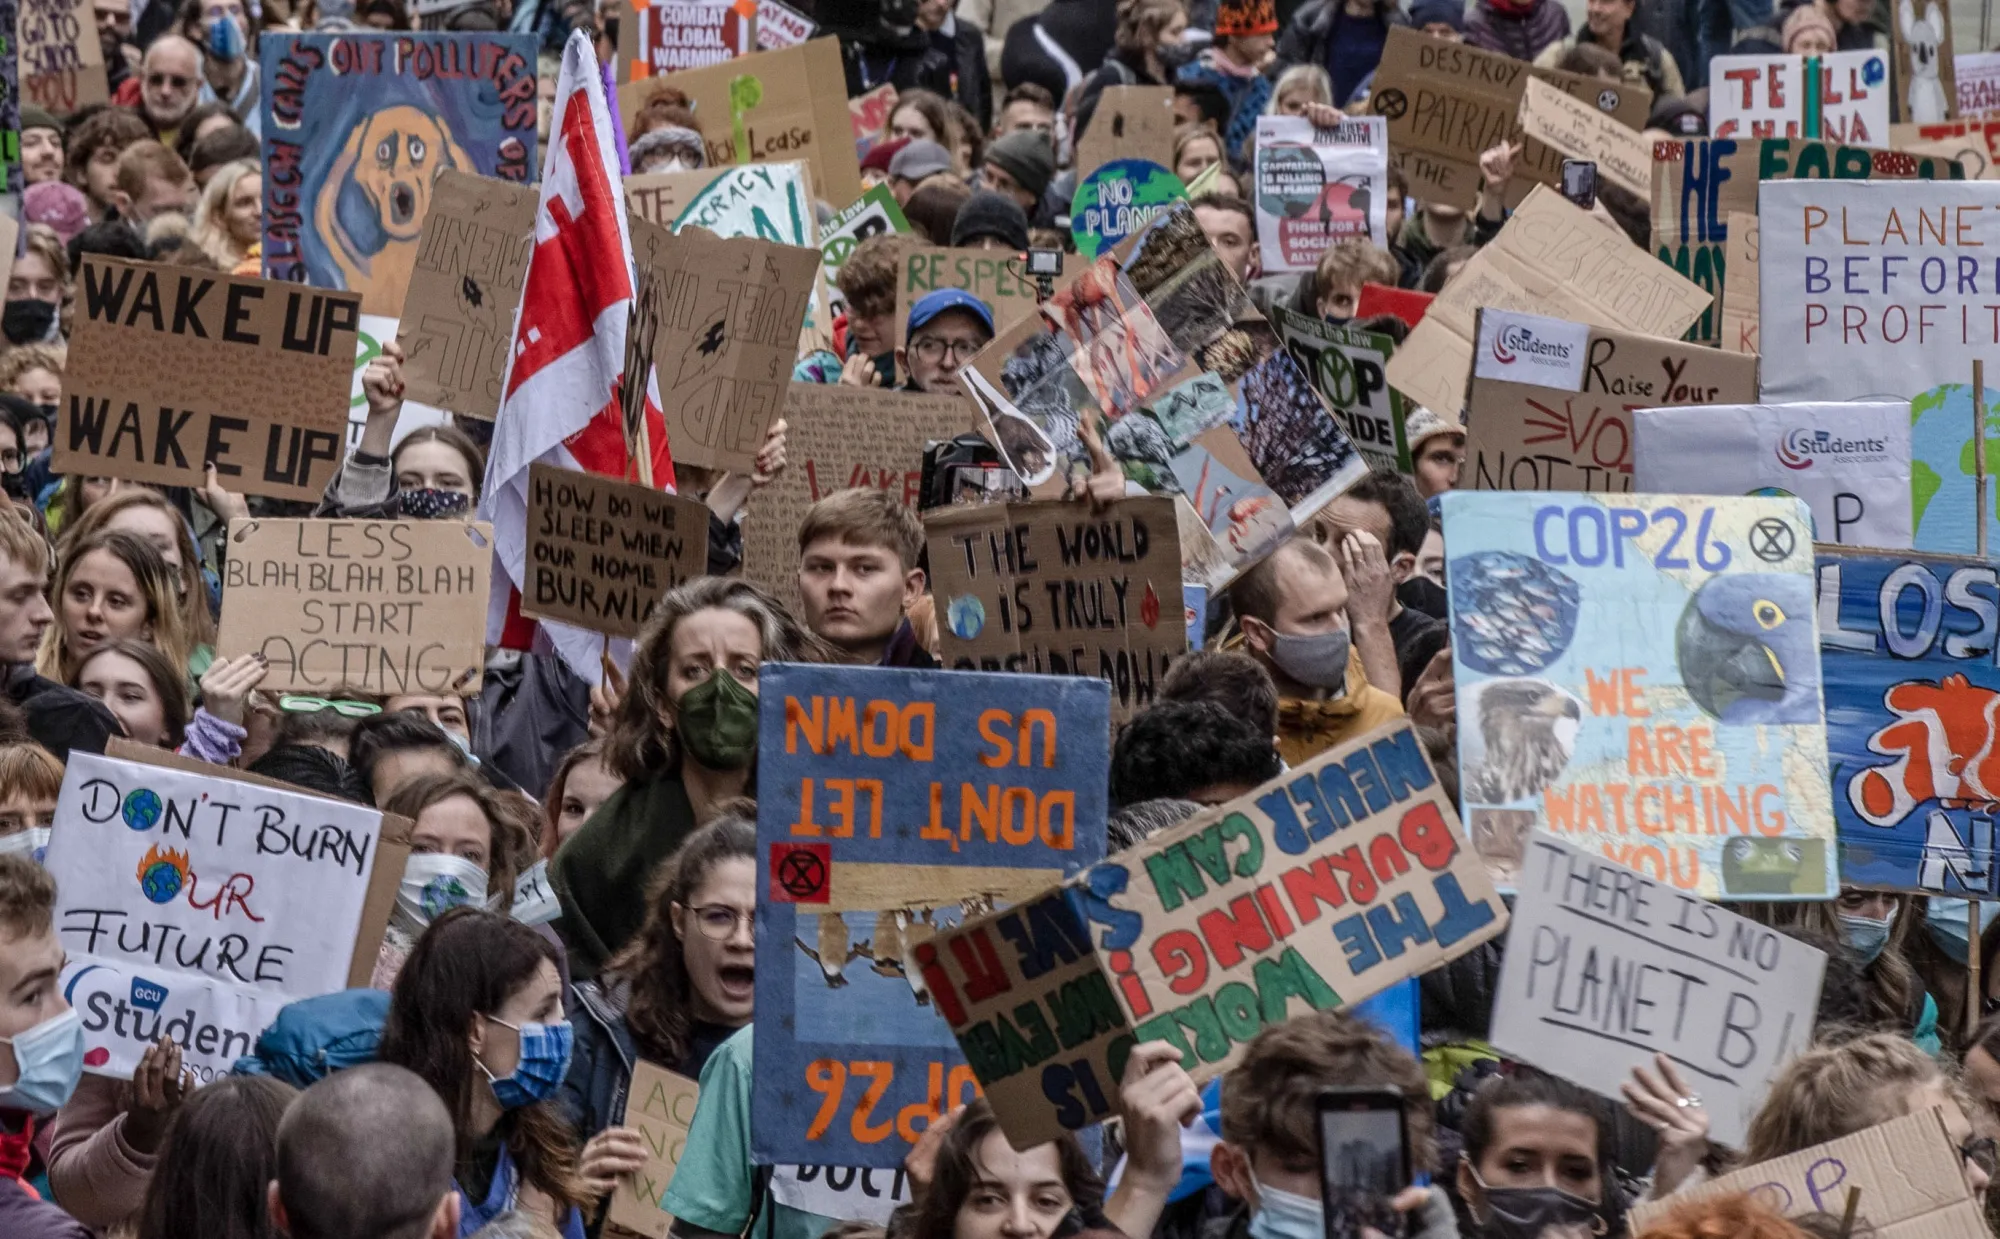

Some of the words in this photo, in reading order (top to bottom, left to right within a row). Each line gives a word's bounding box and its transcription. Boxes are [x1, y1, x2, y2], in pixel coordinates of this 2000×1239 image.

[660, 7, 727, 26] COMBAT
[662, 27, 725, 48] GLOBAL
[328, 38, 386, 77] OUT
[394, 36, 538, 132] POLLUTERS
[653, 48, 733, 67] WARMING
[1419, 44, 1522, 87] DESTROY
[1097, 178, 1132, 207] NO
[1262, 185, 1282, 194] THE
[1276, 173, 1323, 184] KILLING
[1415, 159, 1454, 190] THE
[840, 198, 867, 222] law
[1287, 221, 1325, 234] FIGHT
[1329, 221, 1355, 233] FOR
[1804, 205, 2000, 246] PLANE
[1805, 255, 2000, 295] BEFOR
[82, 262, 265, 346] WAKE
[282, 292, 363, 356] UP
[1347, 327, 1372, 348] law
[1583, 338, 1654, 396] Raise
[1660, 355, 1719, 404] Your
[69, 395, 252, 476] WAKE
[262, 423, 342, 488] UP
[682, 375, 779, 455] END
[535, 477, 596, 515] HOW
[609, 493, 633, 518] DO
[643, 501, 677, 531] WE
[297, 521, 414, 560] LESS
[539, 508, 615, 546] SLEEP
[620, 527, 684, 560] WHEN
[951, 522, 1040, 580] THE
[1054, 517, 1151, 568] WORLD
[1534, 504, 1732, 571] COP26
[397, 565, 476, 595] BLAH
[533, 541, 576, 570] OUR
[591, 552, 658, 590] HOME
[301, 600, 424, 636] START
[1045, 575, 1130, 632] TRULY
[260, 636, 454, 693] ACTING
[1584, 667, 1655, 719] WE
[783, 695, 937, 763] DOWN
[978, 707, 1058, 769] US
[1625, 724, 1719, 778] ARE
[790, 776, 885, 841] LET
[1255, 728, 1435, 855] NEVER
[1543, 783, 1789, 837] WATCHING
[255, 804, 373, 877] BURN
[1143, 810, 1264, 913] CAN
[1603, 842, 1699, 890] YOU
[1108, 799, 1461, 1021] BURNING!
[1332, 871, 1497, 977] THE
[1533, 840, 1655, 928] THERE
[1667, 893, 1720, 939] IS
[1726, 920, 1782, 973] NO
[60, 908, 294, 984] FUTURE
[134, 986, 162, 1003] GCU
[1527, 924, 1709, 1042] PLANET
[1040, 1057, 1111, 1131] IS
